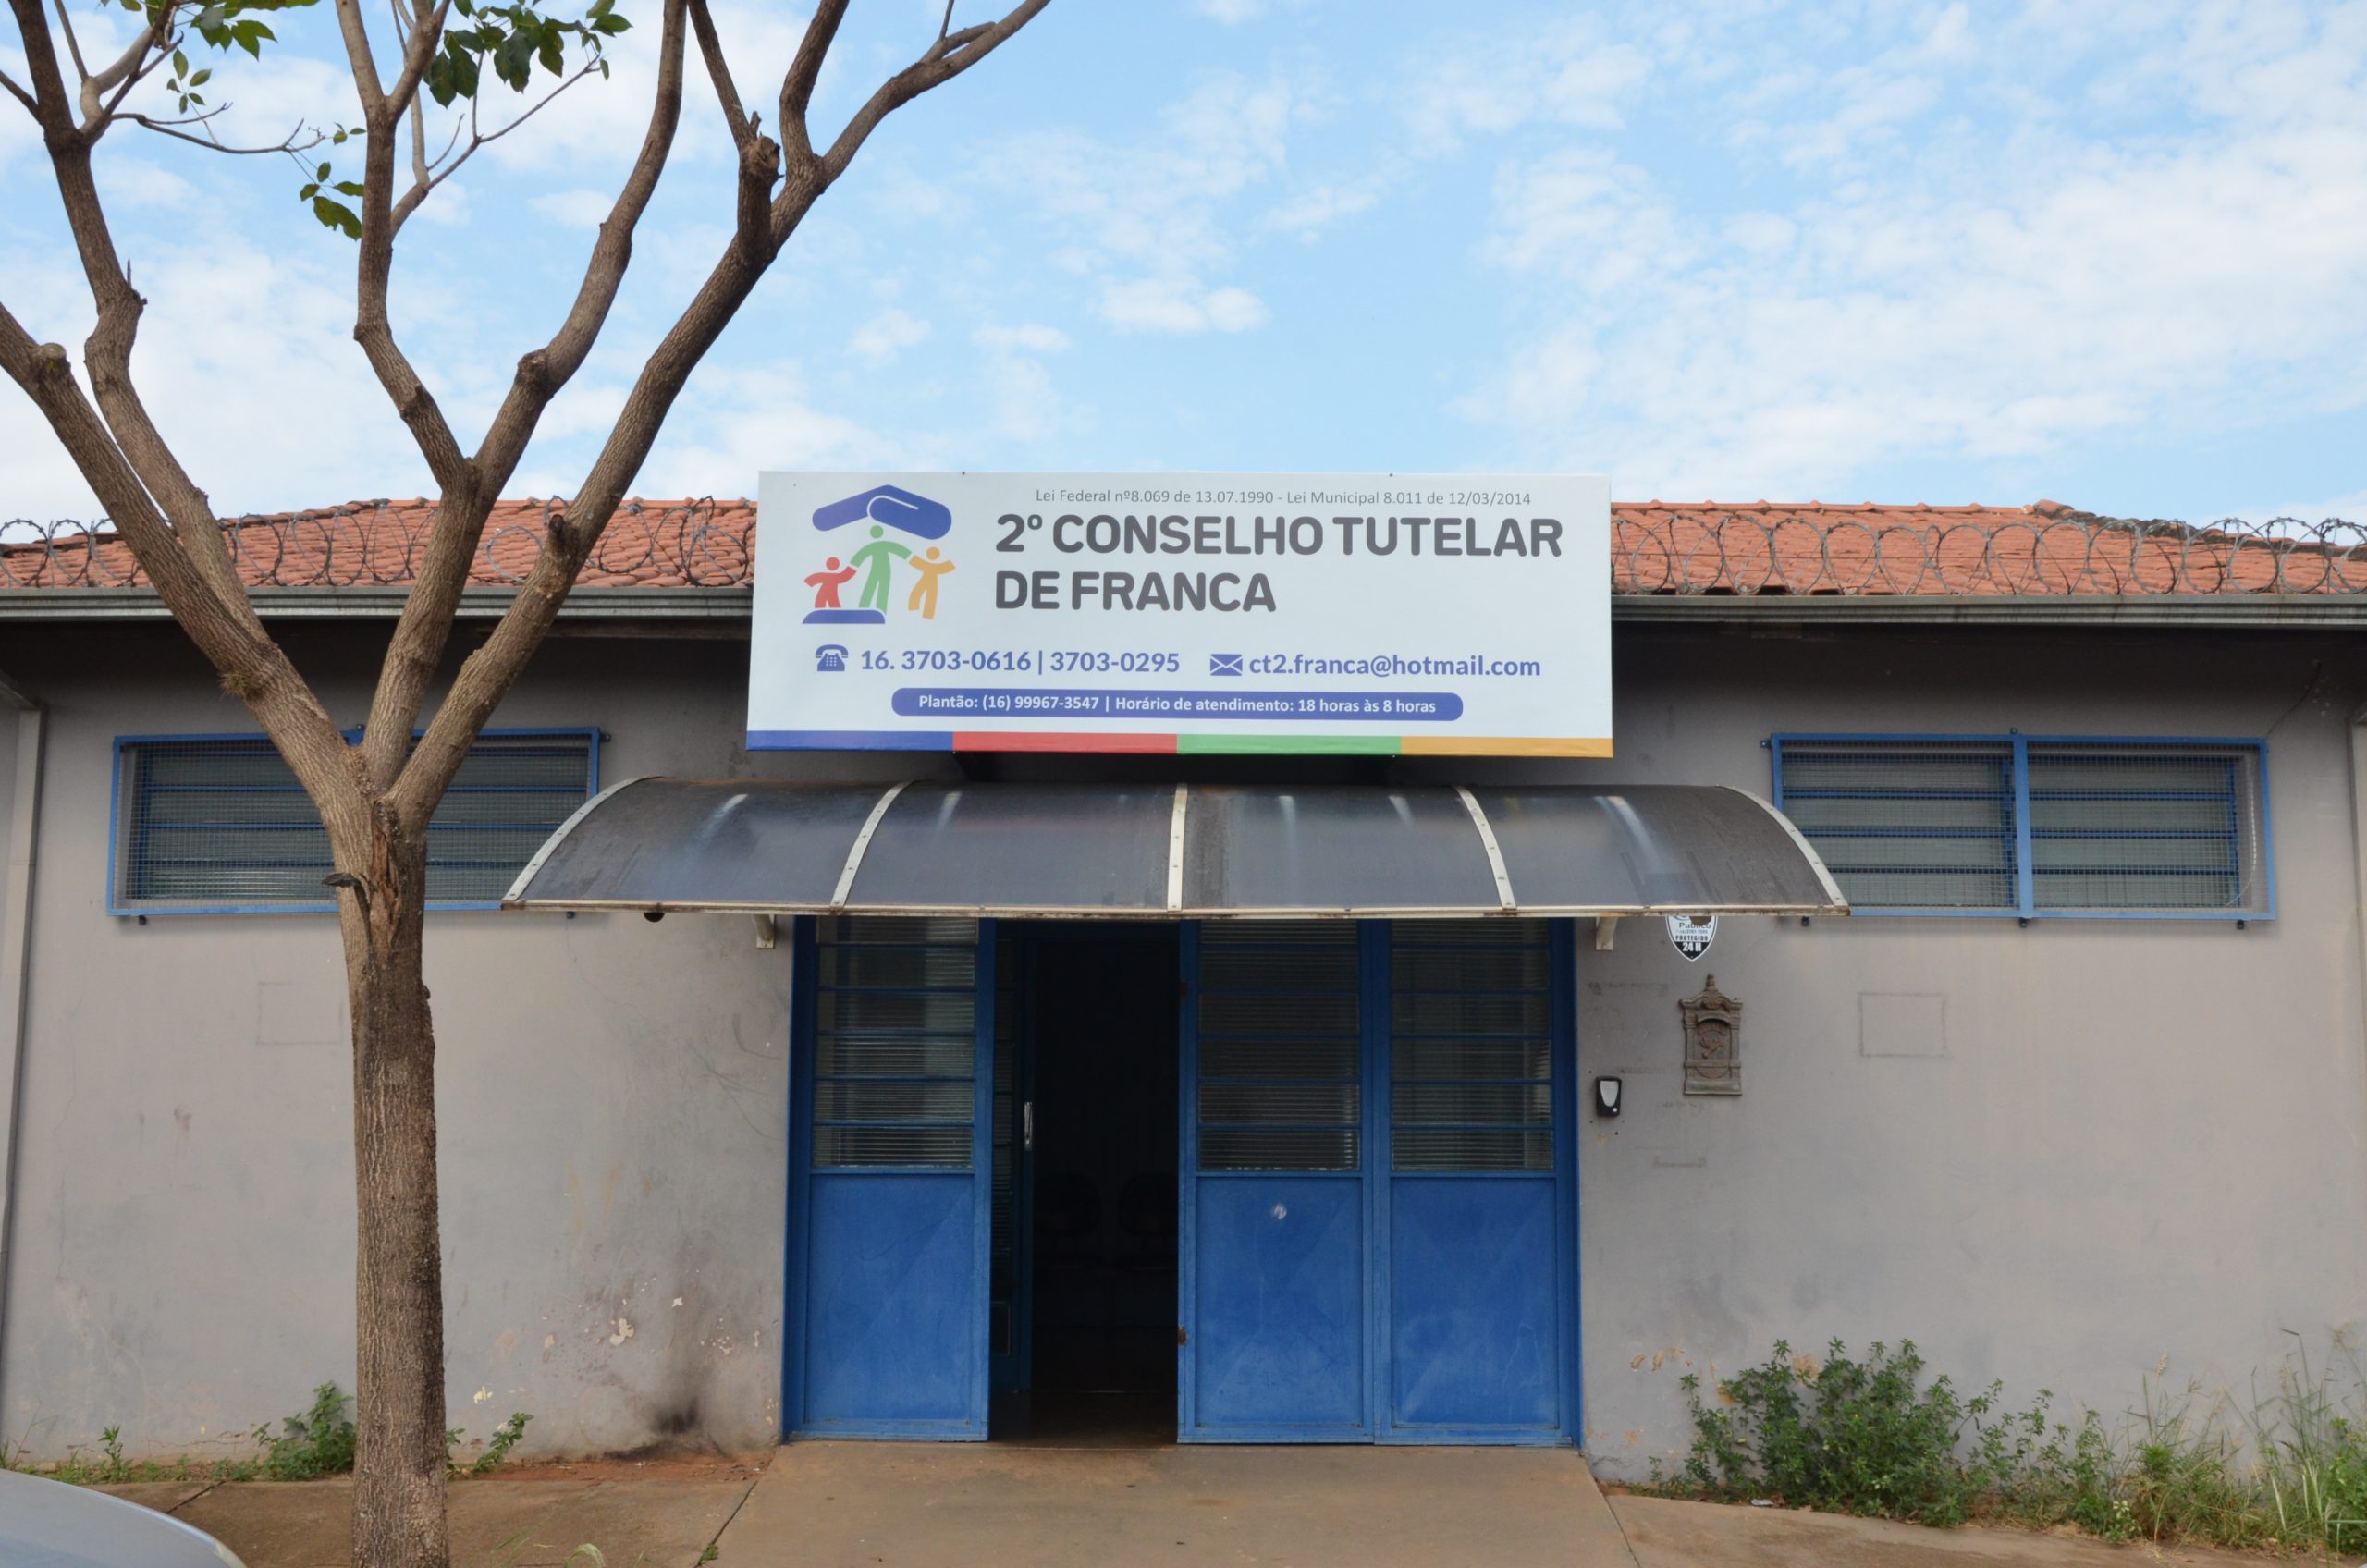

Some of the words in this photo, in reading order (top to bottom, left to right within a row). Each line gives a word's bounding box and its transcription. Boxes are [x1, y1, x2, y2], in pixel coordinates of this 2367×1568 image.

[1036, 489, 1055, 502] Lei
[1060, 489, 1110, 503] Federal
[1114, 490, 1171, 503] nº8.069
[1173, 490, 1191, 503] de
[1196, 490, 1274, 504] 13.07.1990
[1287, 491, 1306, 504] Lei
[1310, 491, 1380, 507] Municipal
[1383, 491, 1422, 505] 8.011
[1427, 491, 1444, 505] de
[1449, 491, 1531, 508] 12/03/2014
[995, 513, 1043, 553] 2º
[1052, 514, 1324, 556] CONSELHO
[1331, 516, 1564, 557] TUTELAR
[995, 570, 1061, 610] DE
[1071, 570, 1277, 613] FRANCA
[861, 650, 896, 670] 16.
[901, 650, 1032, 671] 3703-0616
[1049, 651, 1180, 673] 3703-0295
[1248, 653, 1541, 679] ct2.franca@hotmail.com
[919, 694, 978, 709] Plantão:
[982, 694, 1012, 712] (16)
[1014, 695, 1099, 710] 99967-3547
[1115, 695, 1171, 711] Horário
[1173, 697, 1193, 711] de
[1196, 697, 1294, 712] atendimento:
[1298, 698, 1316, 712] 18
[1319, 698, 1360, 713] horas
[1363, 698, 1380, 713] às
[1382, 699, 1392, 713] 8
[1395, 699, 1437, 713] horas
[1682, 942, 1694, 952] 24
[1695, 942, 1702, 952] H
